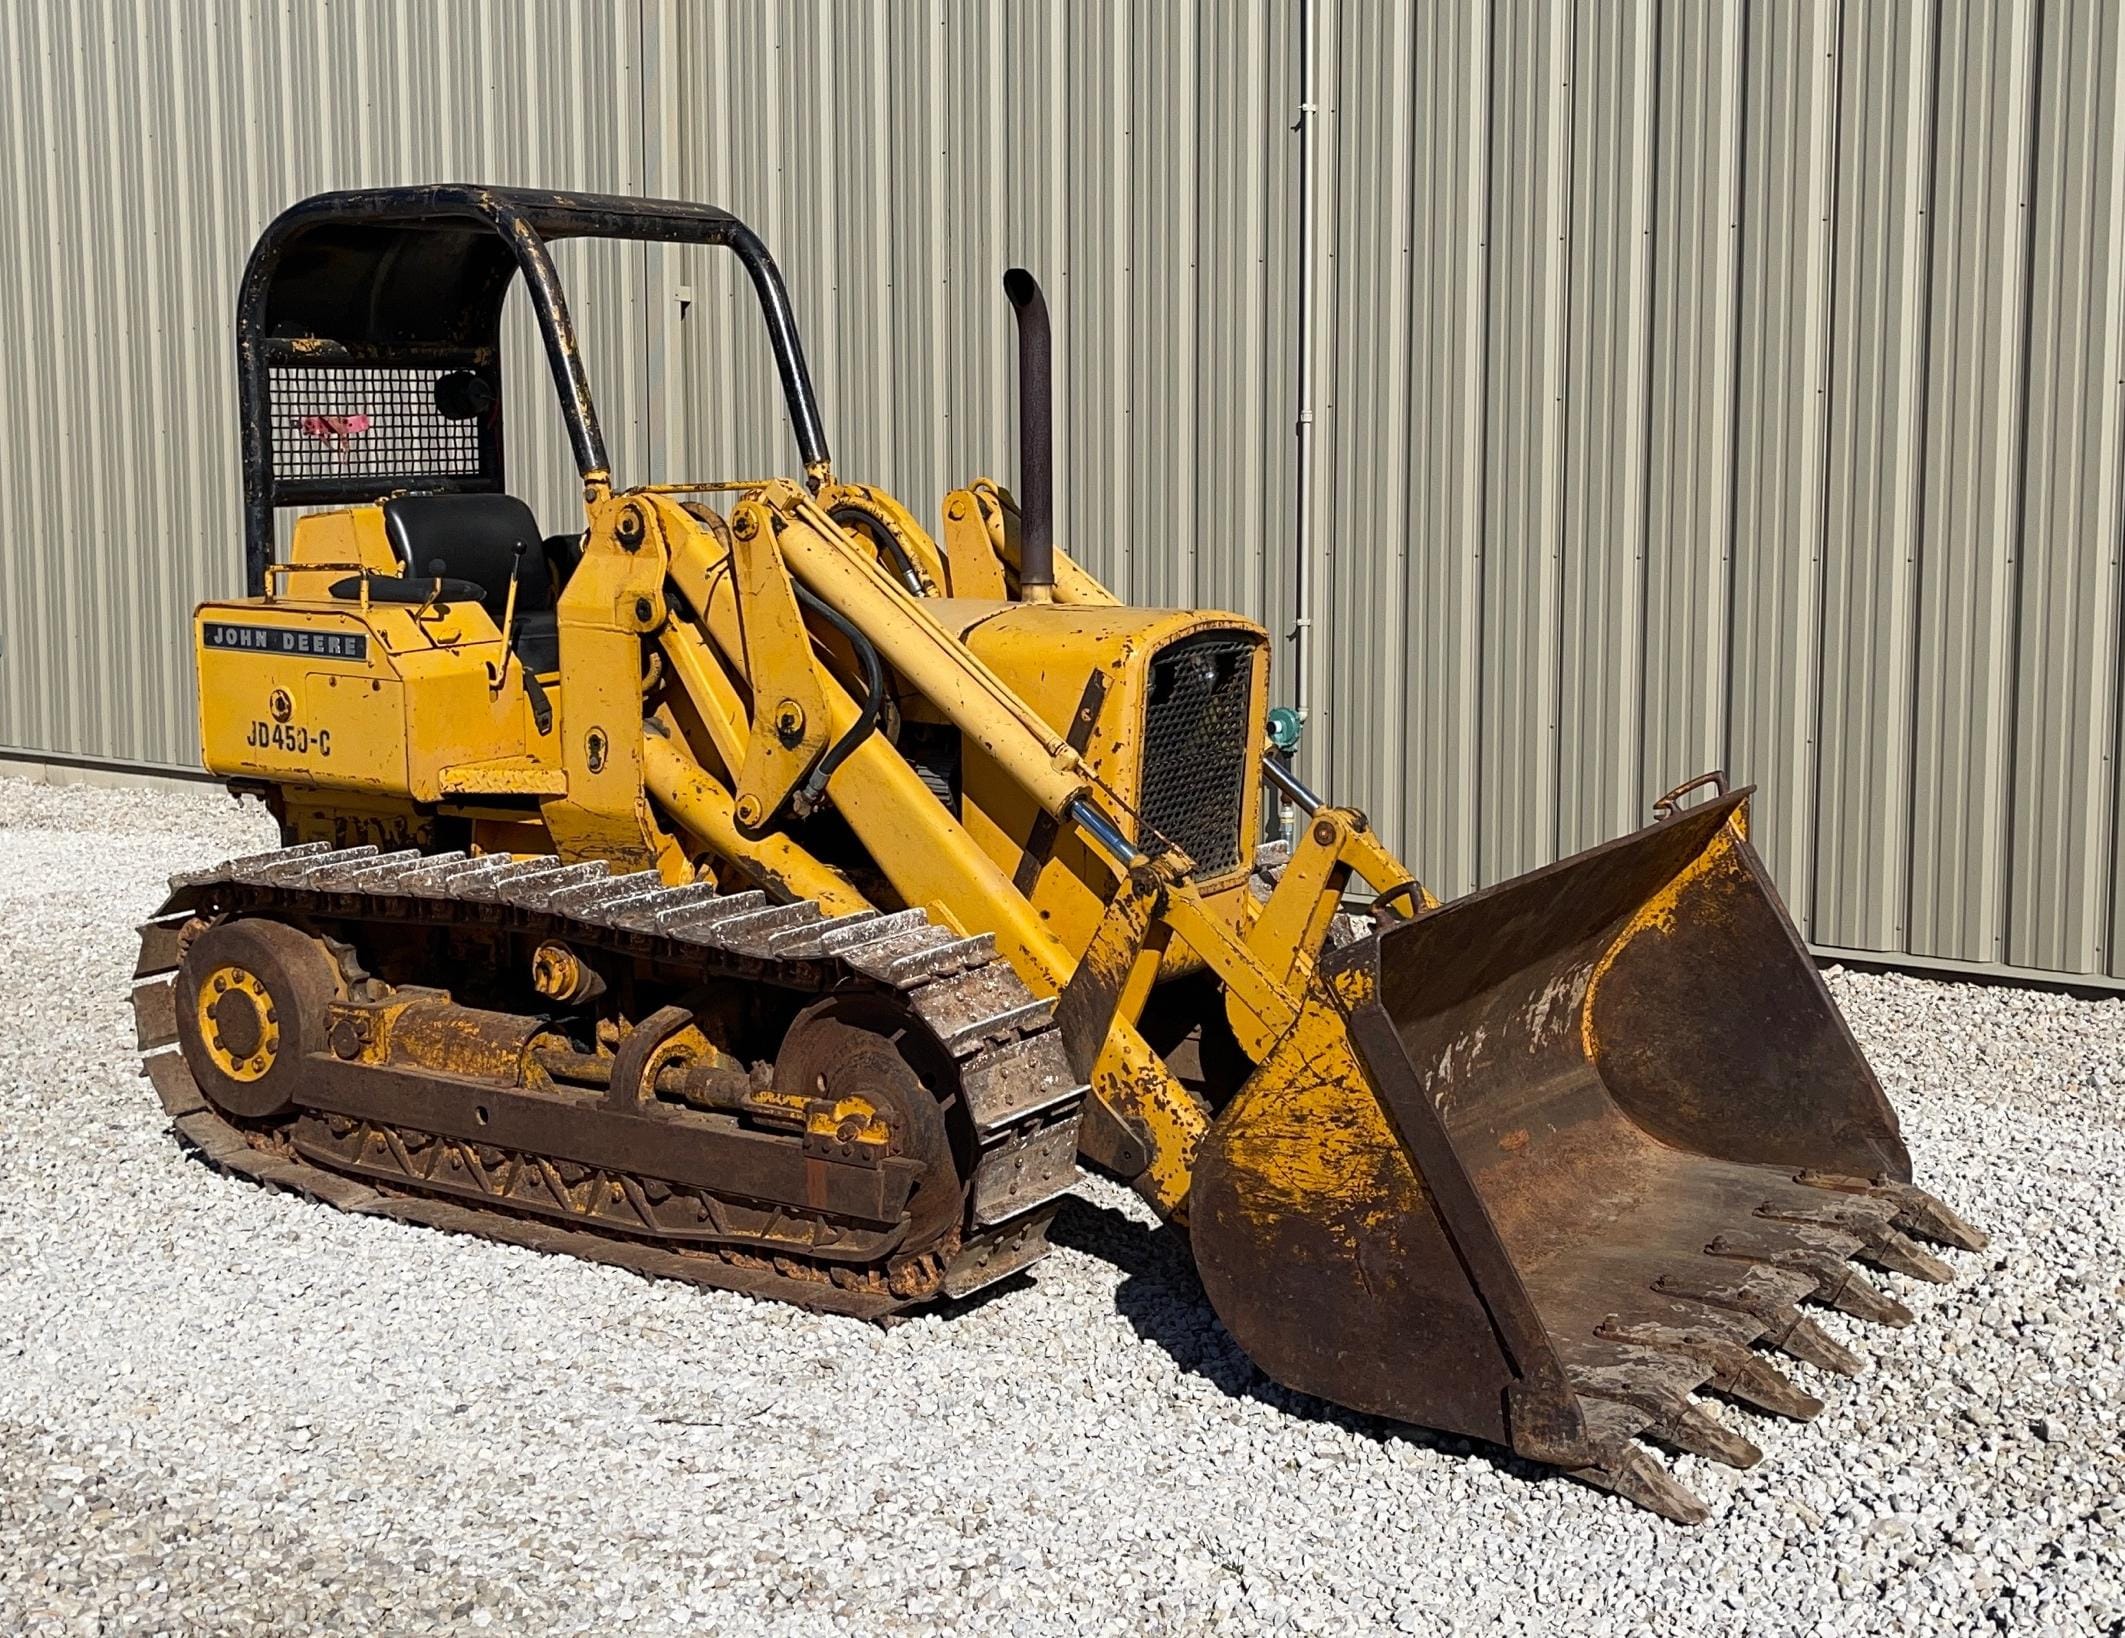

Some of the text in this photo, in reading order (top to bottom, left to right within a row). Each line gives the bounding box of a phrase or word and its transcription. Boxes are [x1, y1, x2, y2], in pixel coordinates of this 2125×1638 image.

[214, 627, 356, 655] JOHN DEERE
[247, 721, 331, 757] JD450-C
